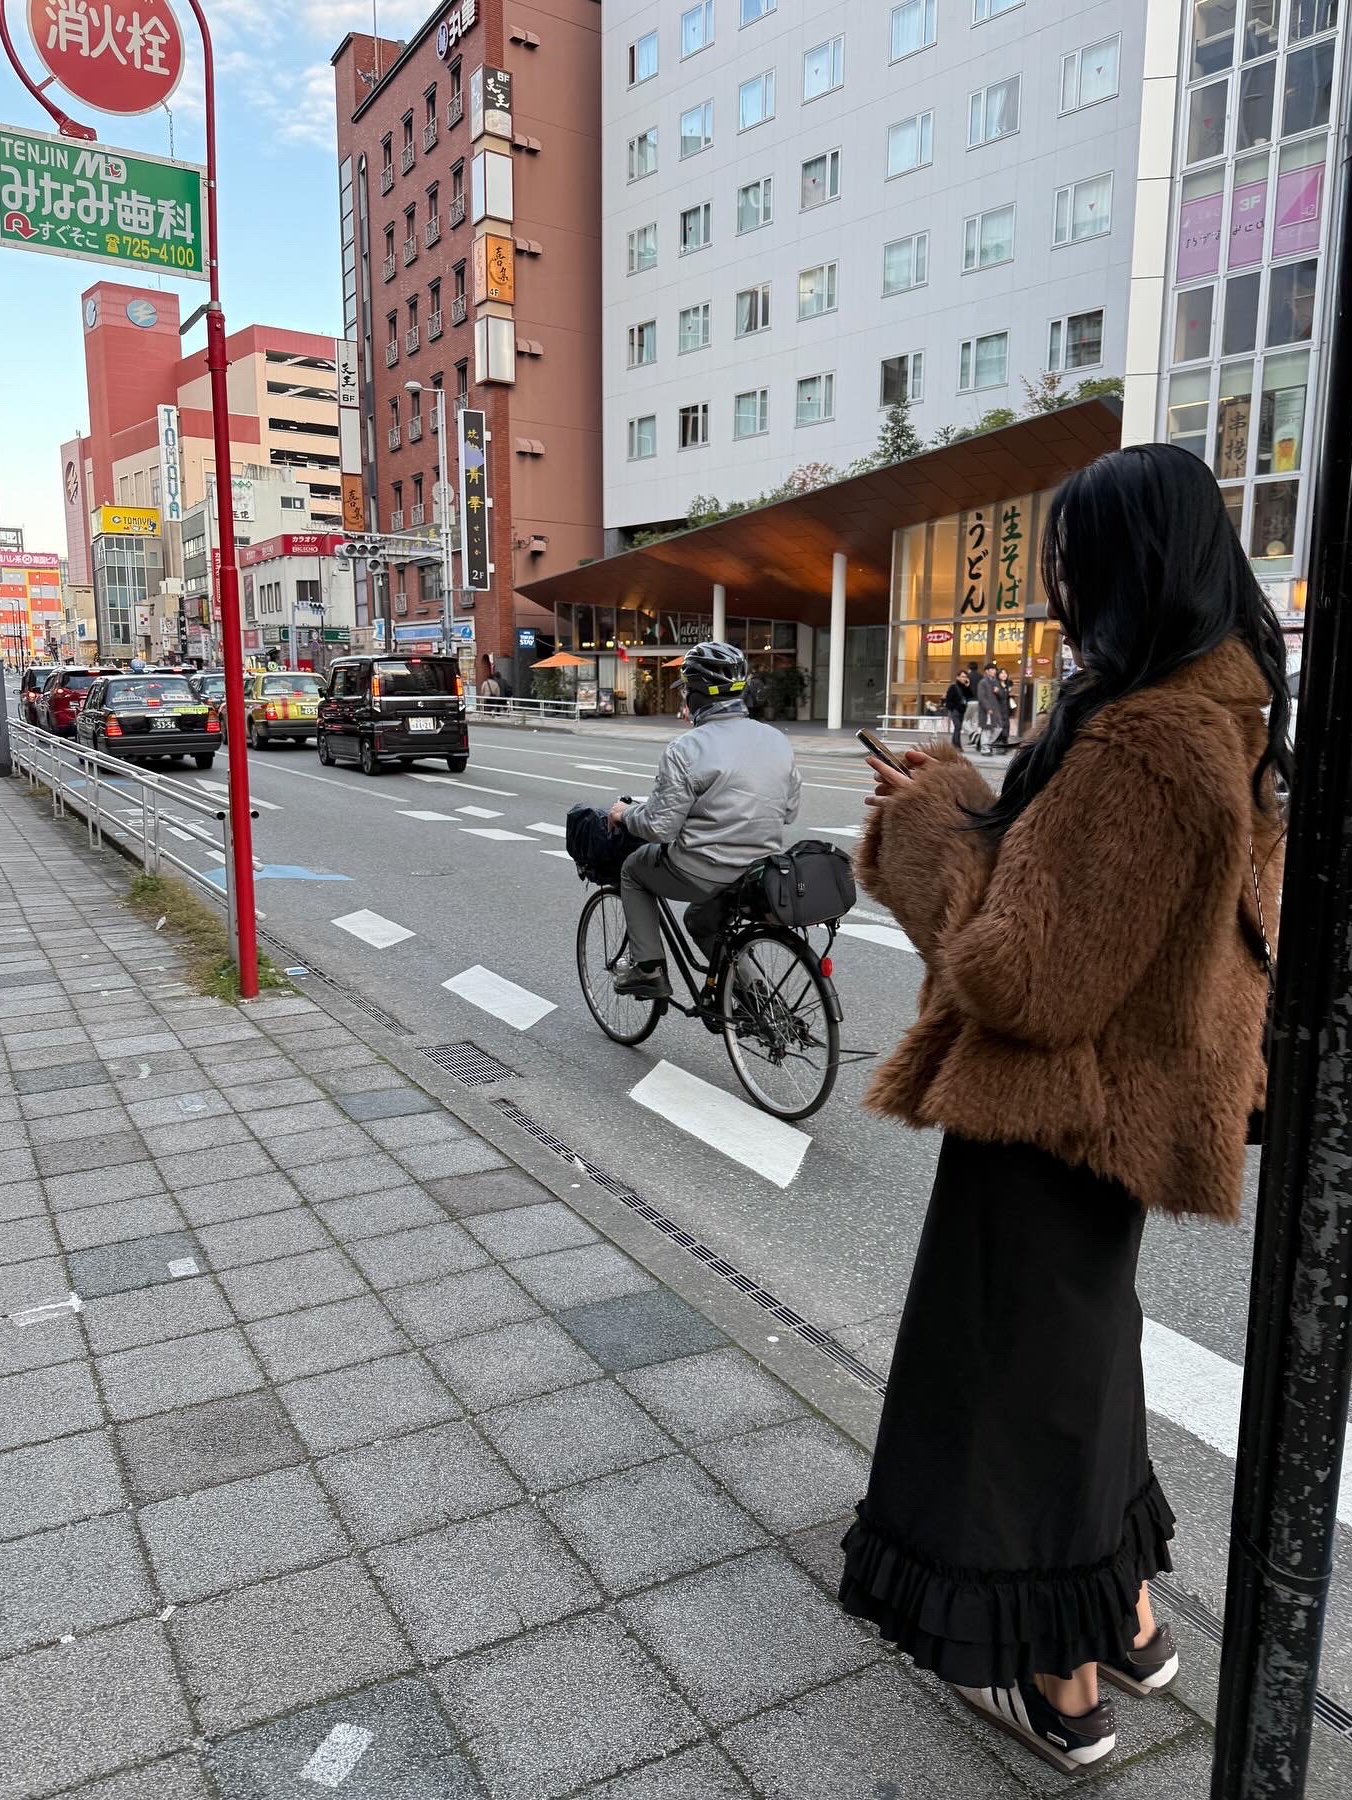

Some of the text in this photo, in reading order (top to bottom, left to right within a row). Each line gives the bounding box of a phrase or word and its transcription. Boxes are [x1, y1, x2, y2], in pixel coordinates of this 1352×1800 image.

[45, 0, 170, 76] 消火栓
[0, 137, 69, 170] TENJIN
[0, 164, 195, 245] みなみ歯科
[38, 222, 99, 250] すぐそこ
[122, 236, 195, 268] 725-4100
[472, 569, 485, 580] 2F
[960, 512, 989, 614] うどん
[996, 506, 1023, 612] 生そば
